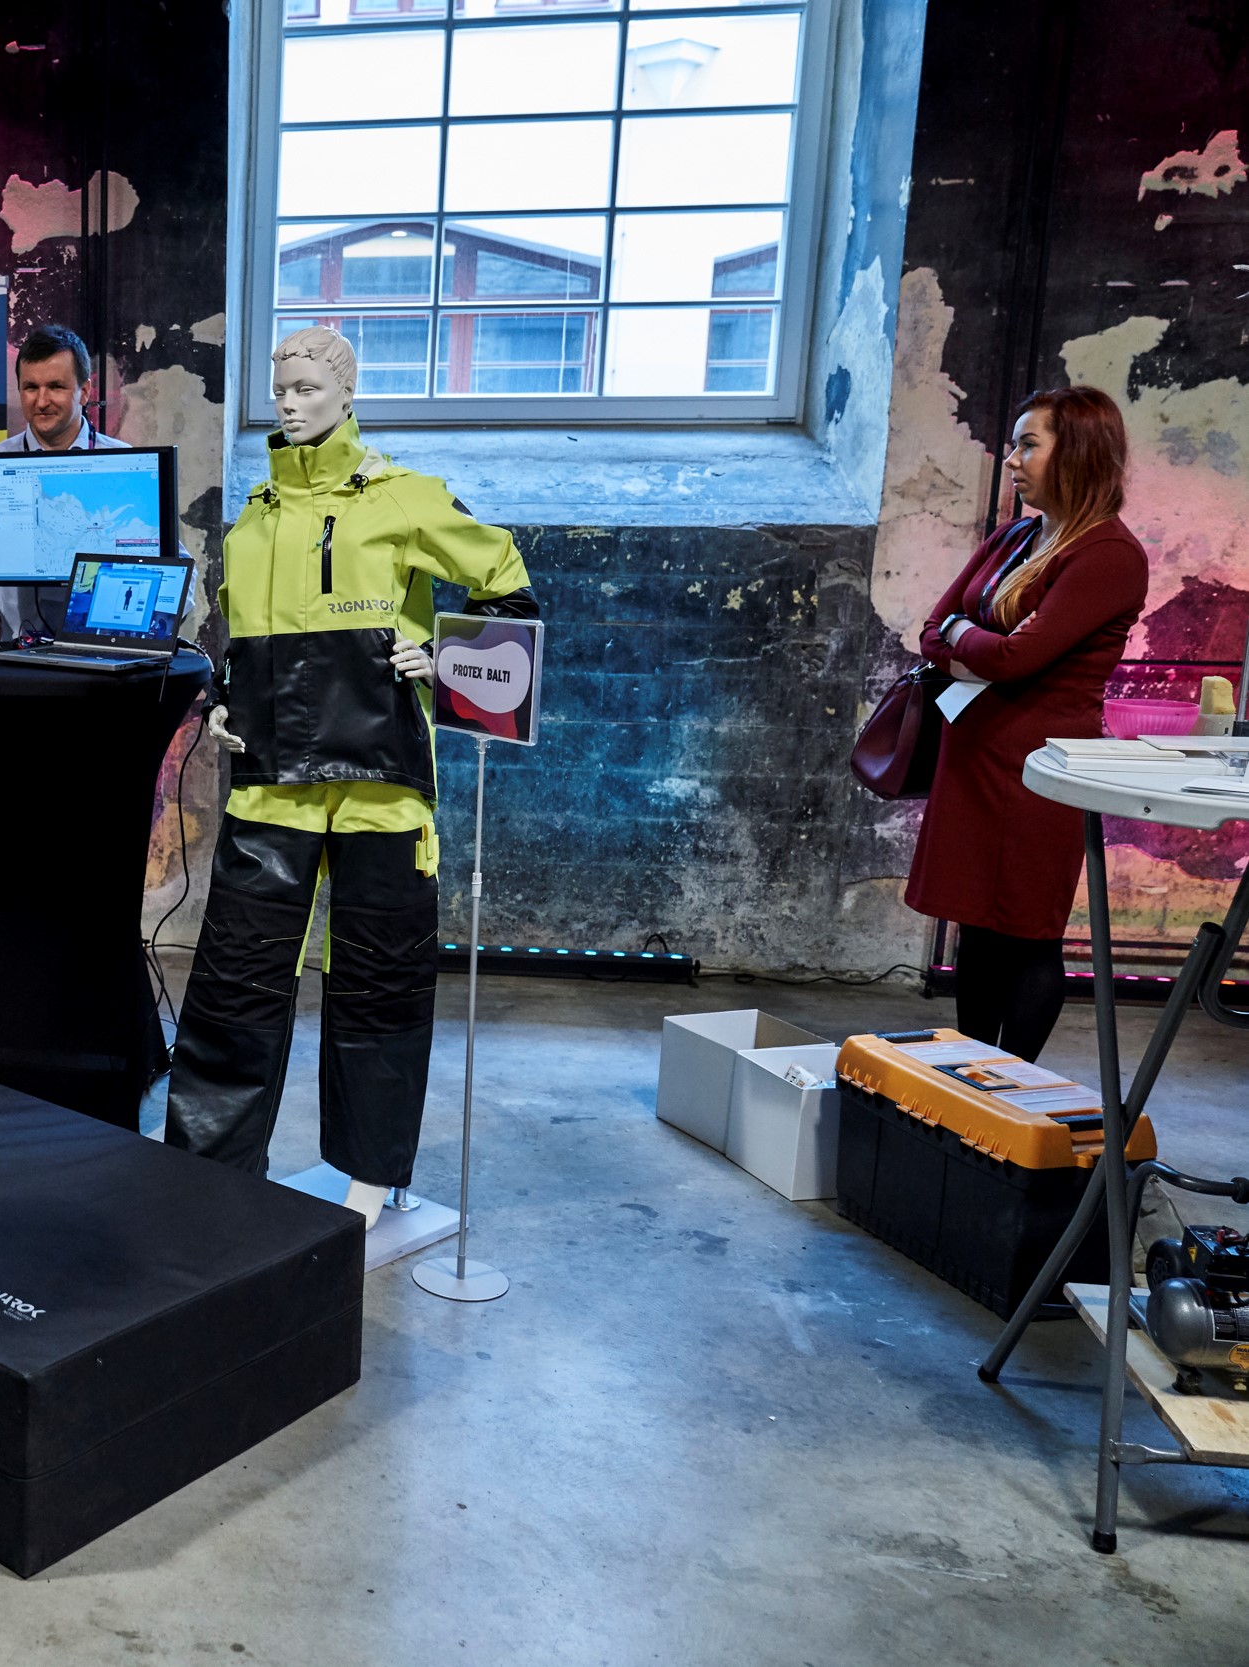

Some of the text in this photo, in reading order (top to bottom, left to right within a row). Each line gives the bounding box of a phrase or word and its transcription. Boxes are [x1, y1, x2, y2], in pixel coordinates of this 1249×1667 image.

[328, 600, 394, 614] RAGNAROK
[453, 663, 510, 683] PROTEX BALTI
